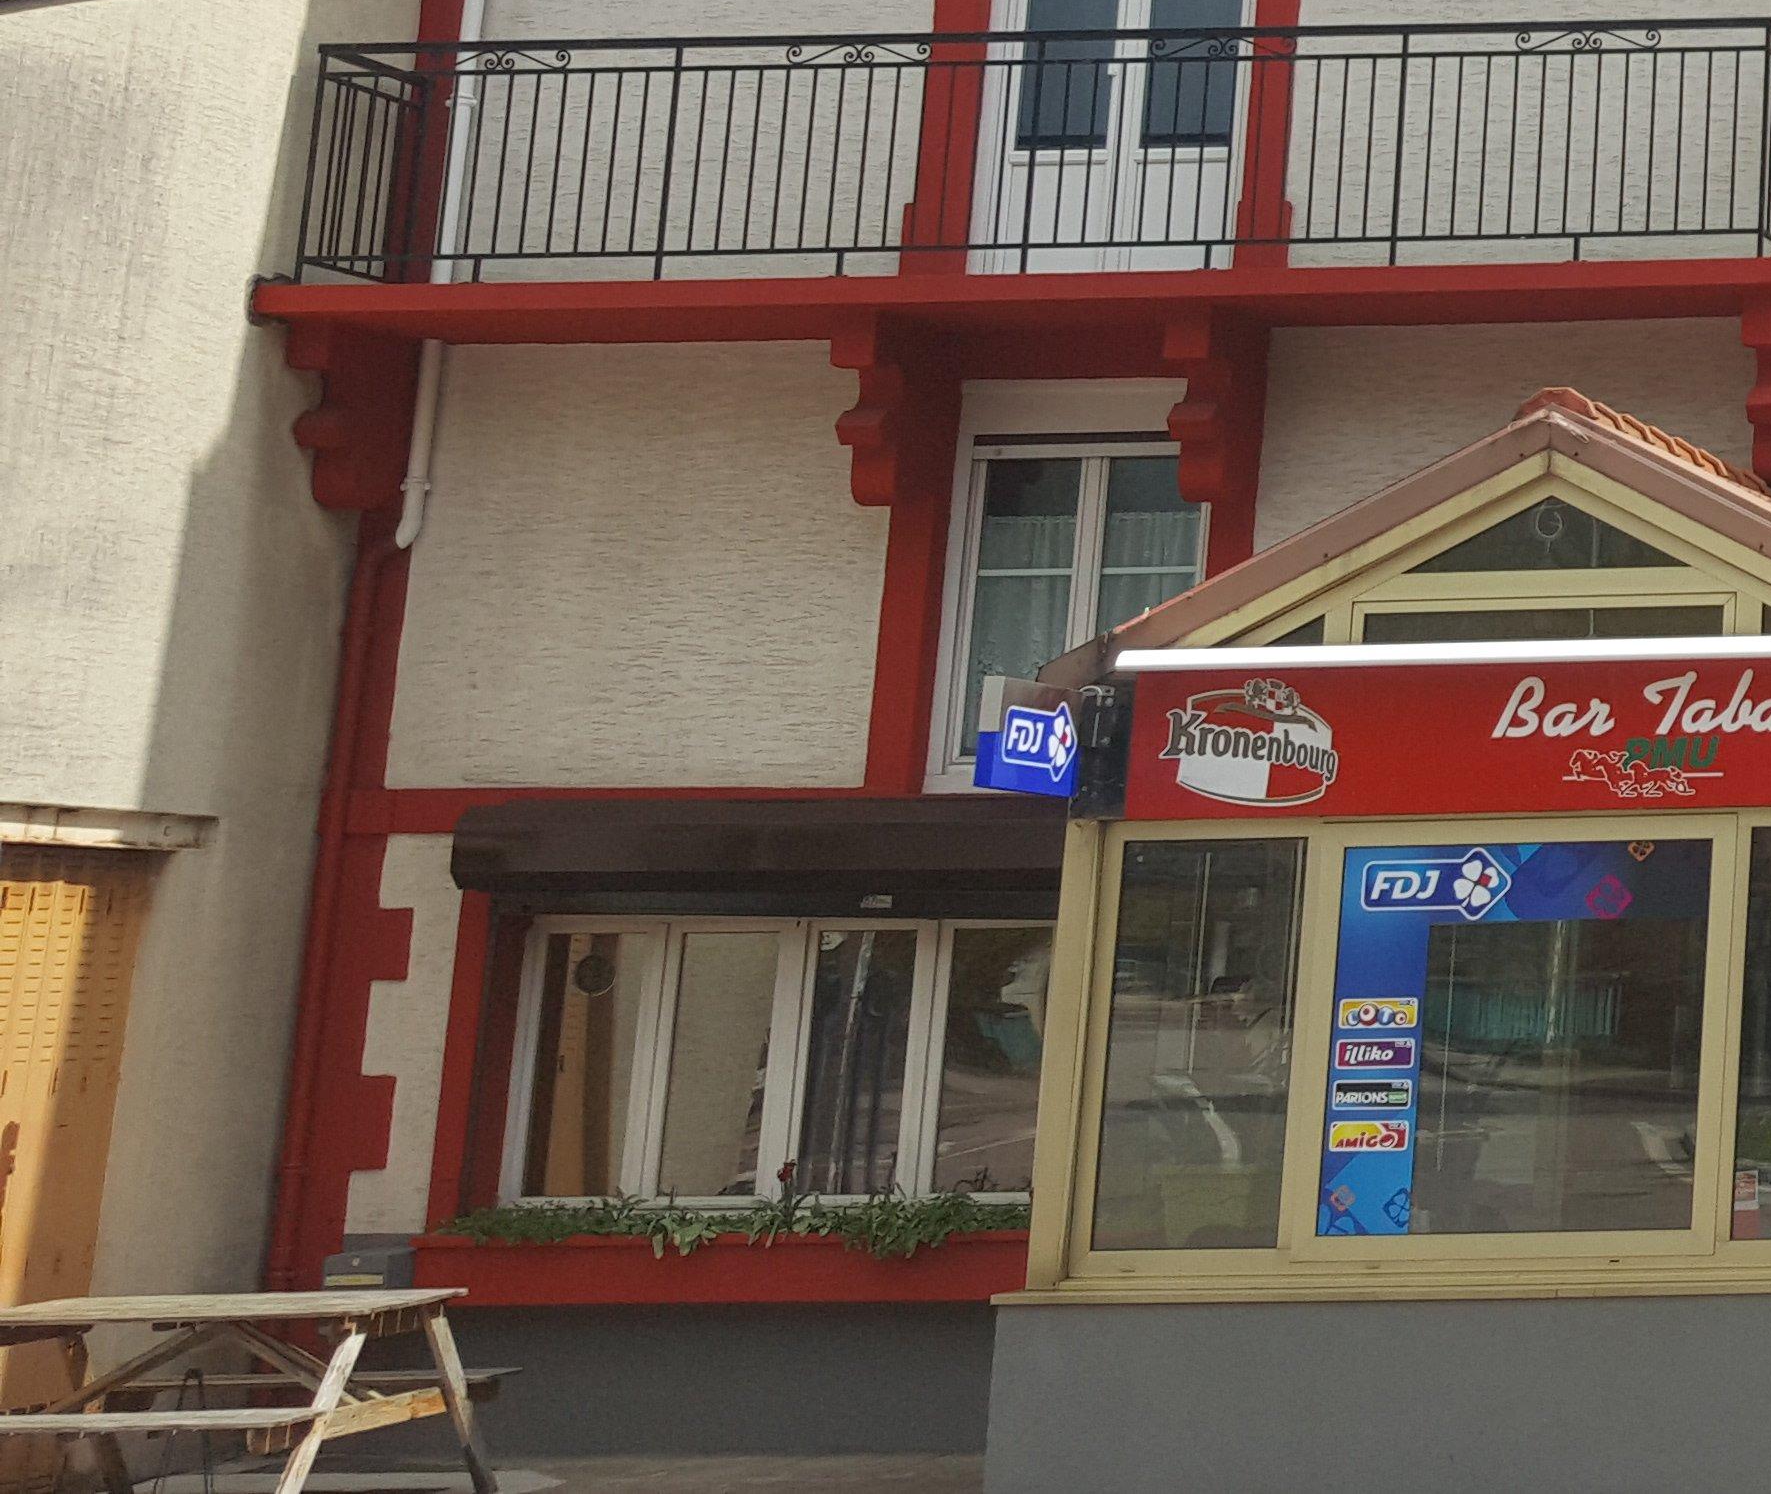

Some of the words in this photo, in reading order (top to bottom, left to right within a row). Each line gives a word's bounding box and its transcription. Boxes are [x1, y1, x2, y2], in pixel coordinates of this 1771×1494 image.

[1491, 675, 1615, 739] Bar
[1005, 718, 1043, 754] FDJ
[1160, 710, 1339, 784] Kronenbourg
[1623, 736, 1720, 772] PMU
[1369, 869, 1441, 900] FDJ
[1346, 1003, 1408, 1026] LOTO
[1344, 1044, 1394, 1065] illiko
[1335, 1091, 1388, 1104] PARIONS
[1334, 1131, 1396, 1148] AMIGO
